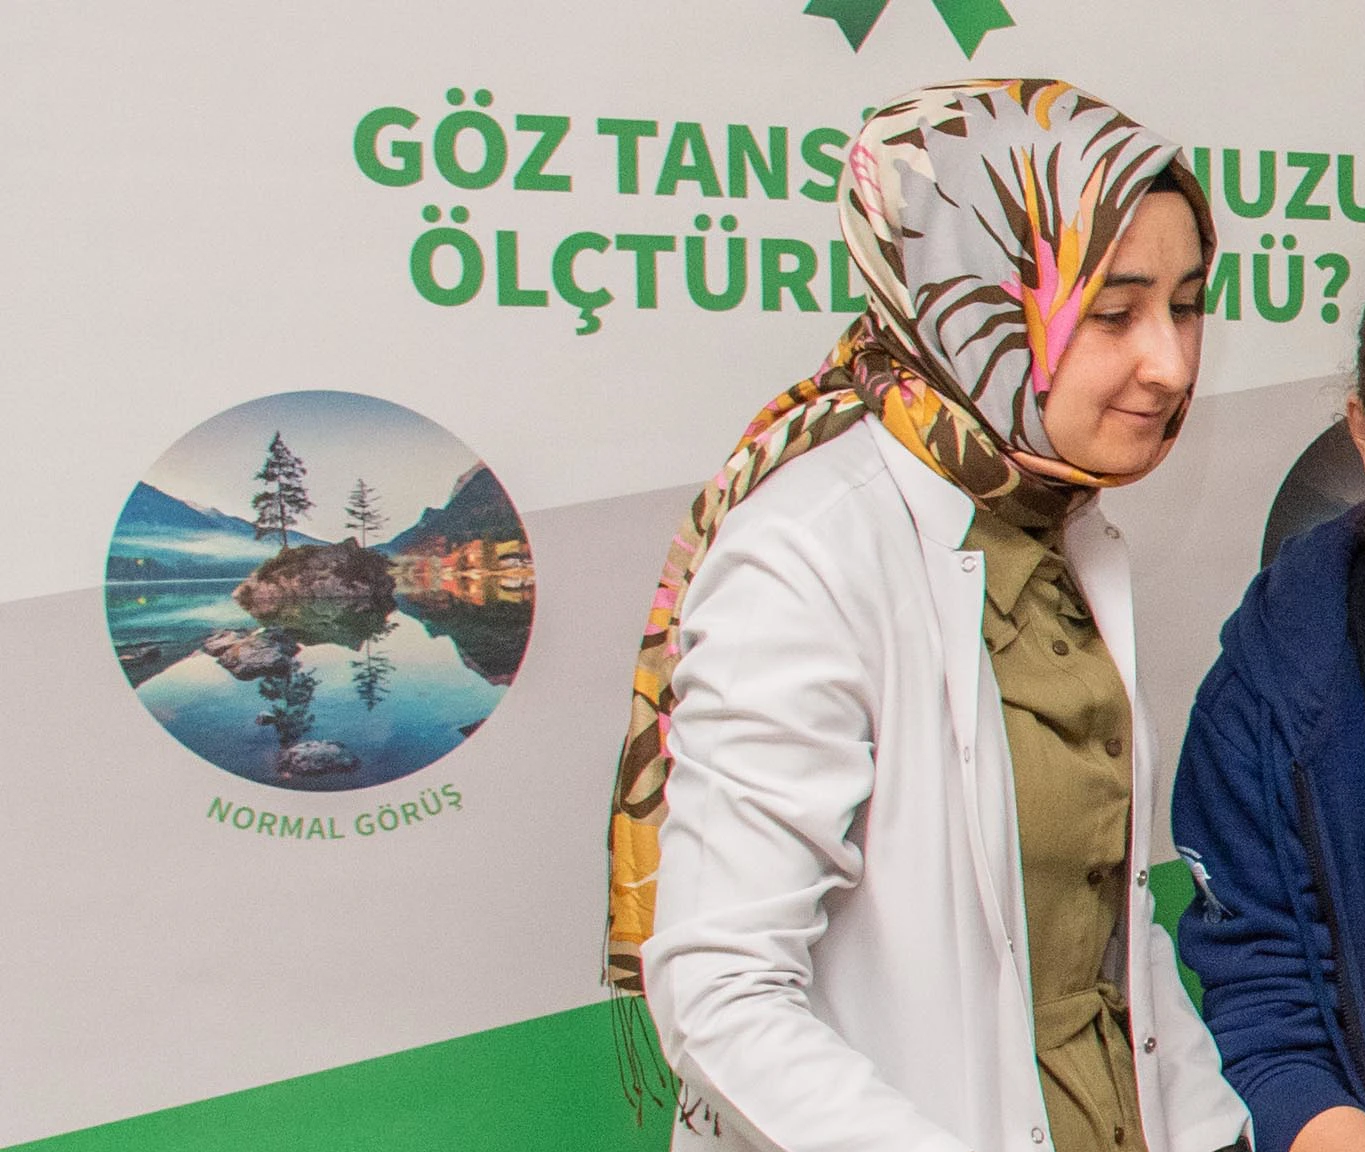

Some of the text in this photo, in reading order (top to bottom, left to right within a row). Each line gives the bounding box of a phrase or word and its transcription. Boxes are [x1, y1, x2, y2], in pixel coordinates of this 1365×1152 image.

[353, 87, 574, 194] GÖZ
[206, 783, 464, 840] NORMAL GÖRÜŞ
